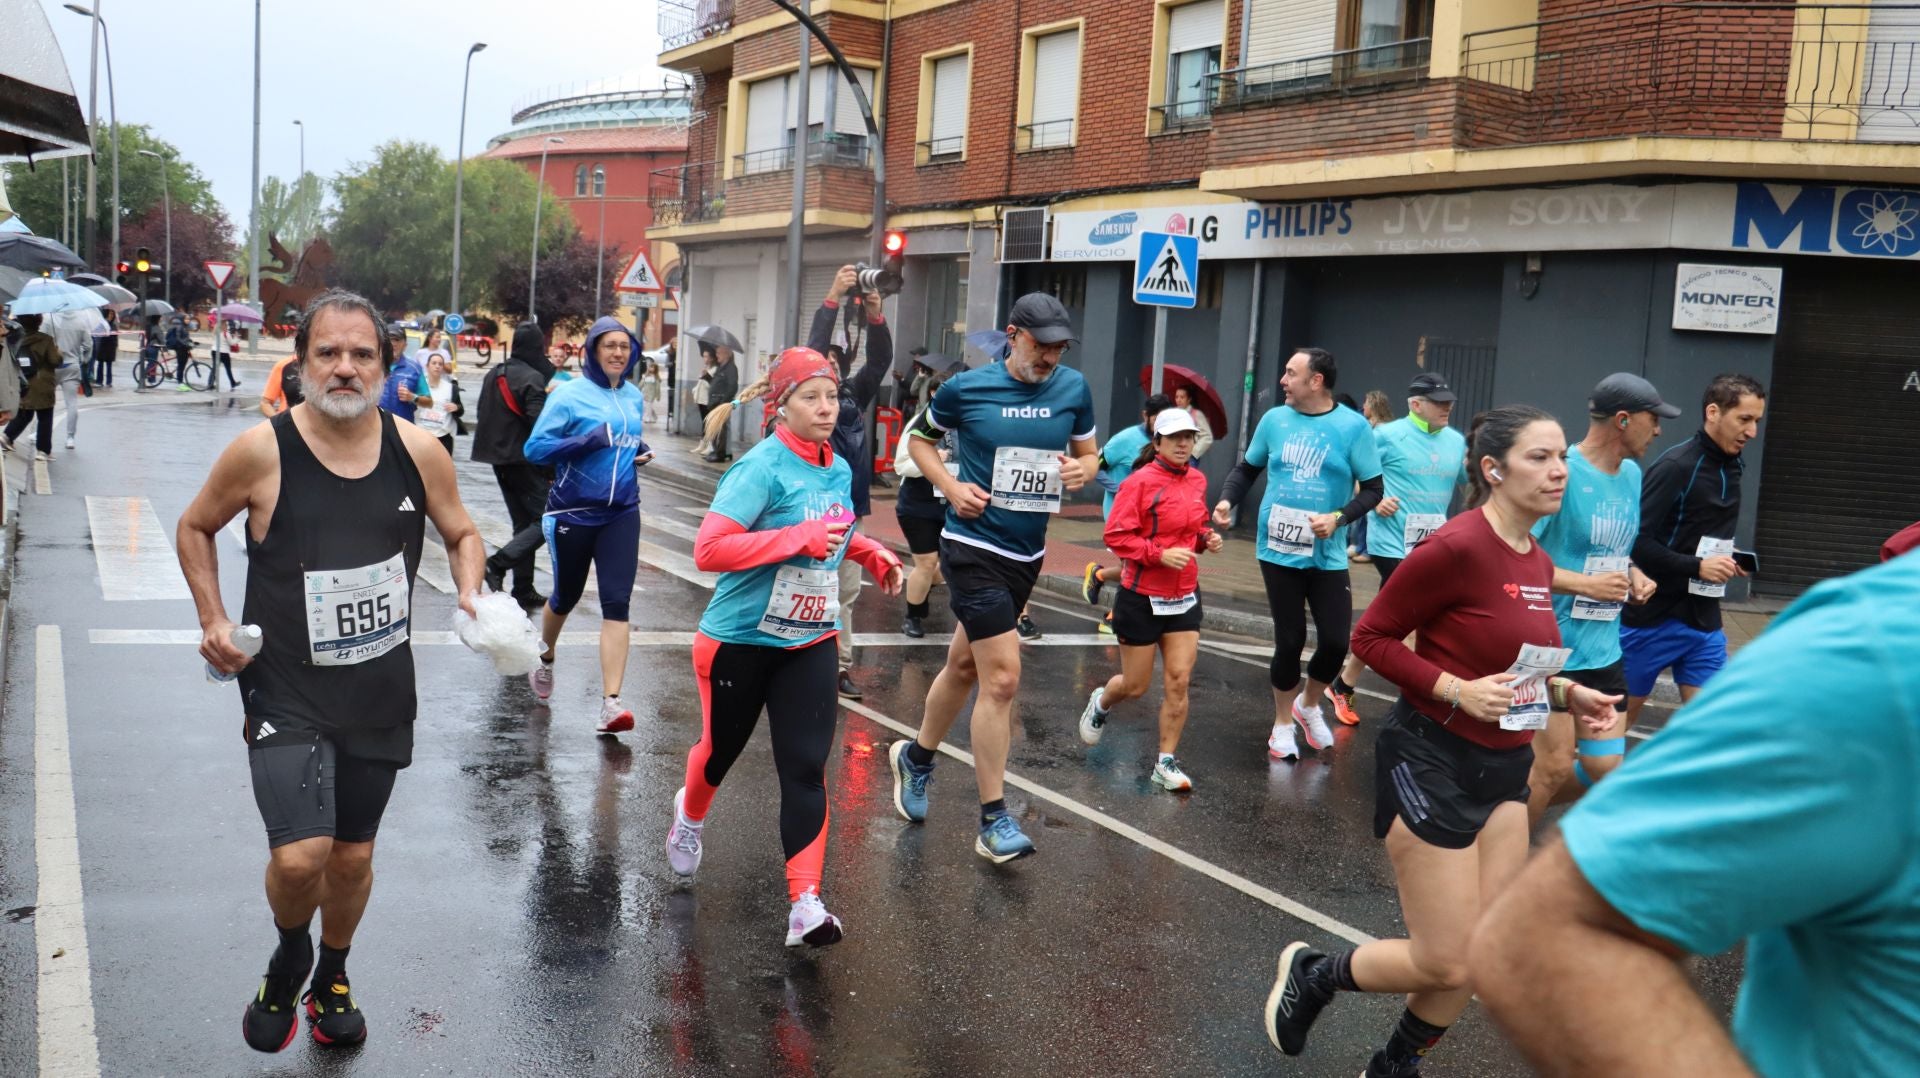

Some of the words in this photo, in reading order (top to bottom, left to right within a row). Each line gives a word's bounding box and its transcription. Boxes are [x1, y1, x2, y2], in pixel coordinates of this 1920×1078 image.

[1245, 202, 1353, 240] PHILIPS
[1381, 195, 1471, 235] JVC
[1507, 192, 1651, 227] SONY
[1054, 247, 1126, 259] SERVICIO
[1375, 237, 1481, 253] TECNICA
[1681, 271, 1711, 290] SERVICIO
[1714, 268, 1748, 278] TECNICO
[1752, 274, 1777, 295] OFICIAL
[1681, 291, 1777, 309] MONFER
[1704, 320, 1729, 330] VIDEO
[1742, 312, 1773, 329] SONIDO
[1002, 405, 1051, 419] indra
[1011, 469, 1048, 493] 798
[1277, 522, 1303, 542] 927
[353, 588, 378, 600] ENRIC
[336, 593, 391, 638] 695
[787, 593, 827, 621] 788
[356, 633, 398, 657] HYUNDAI
